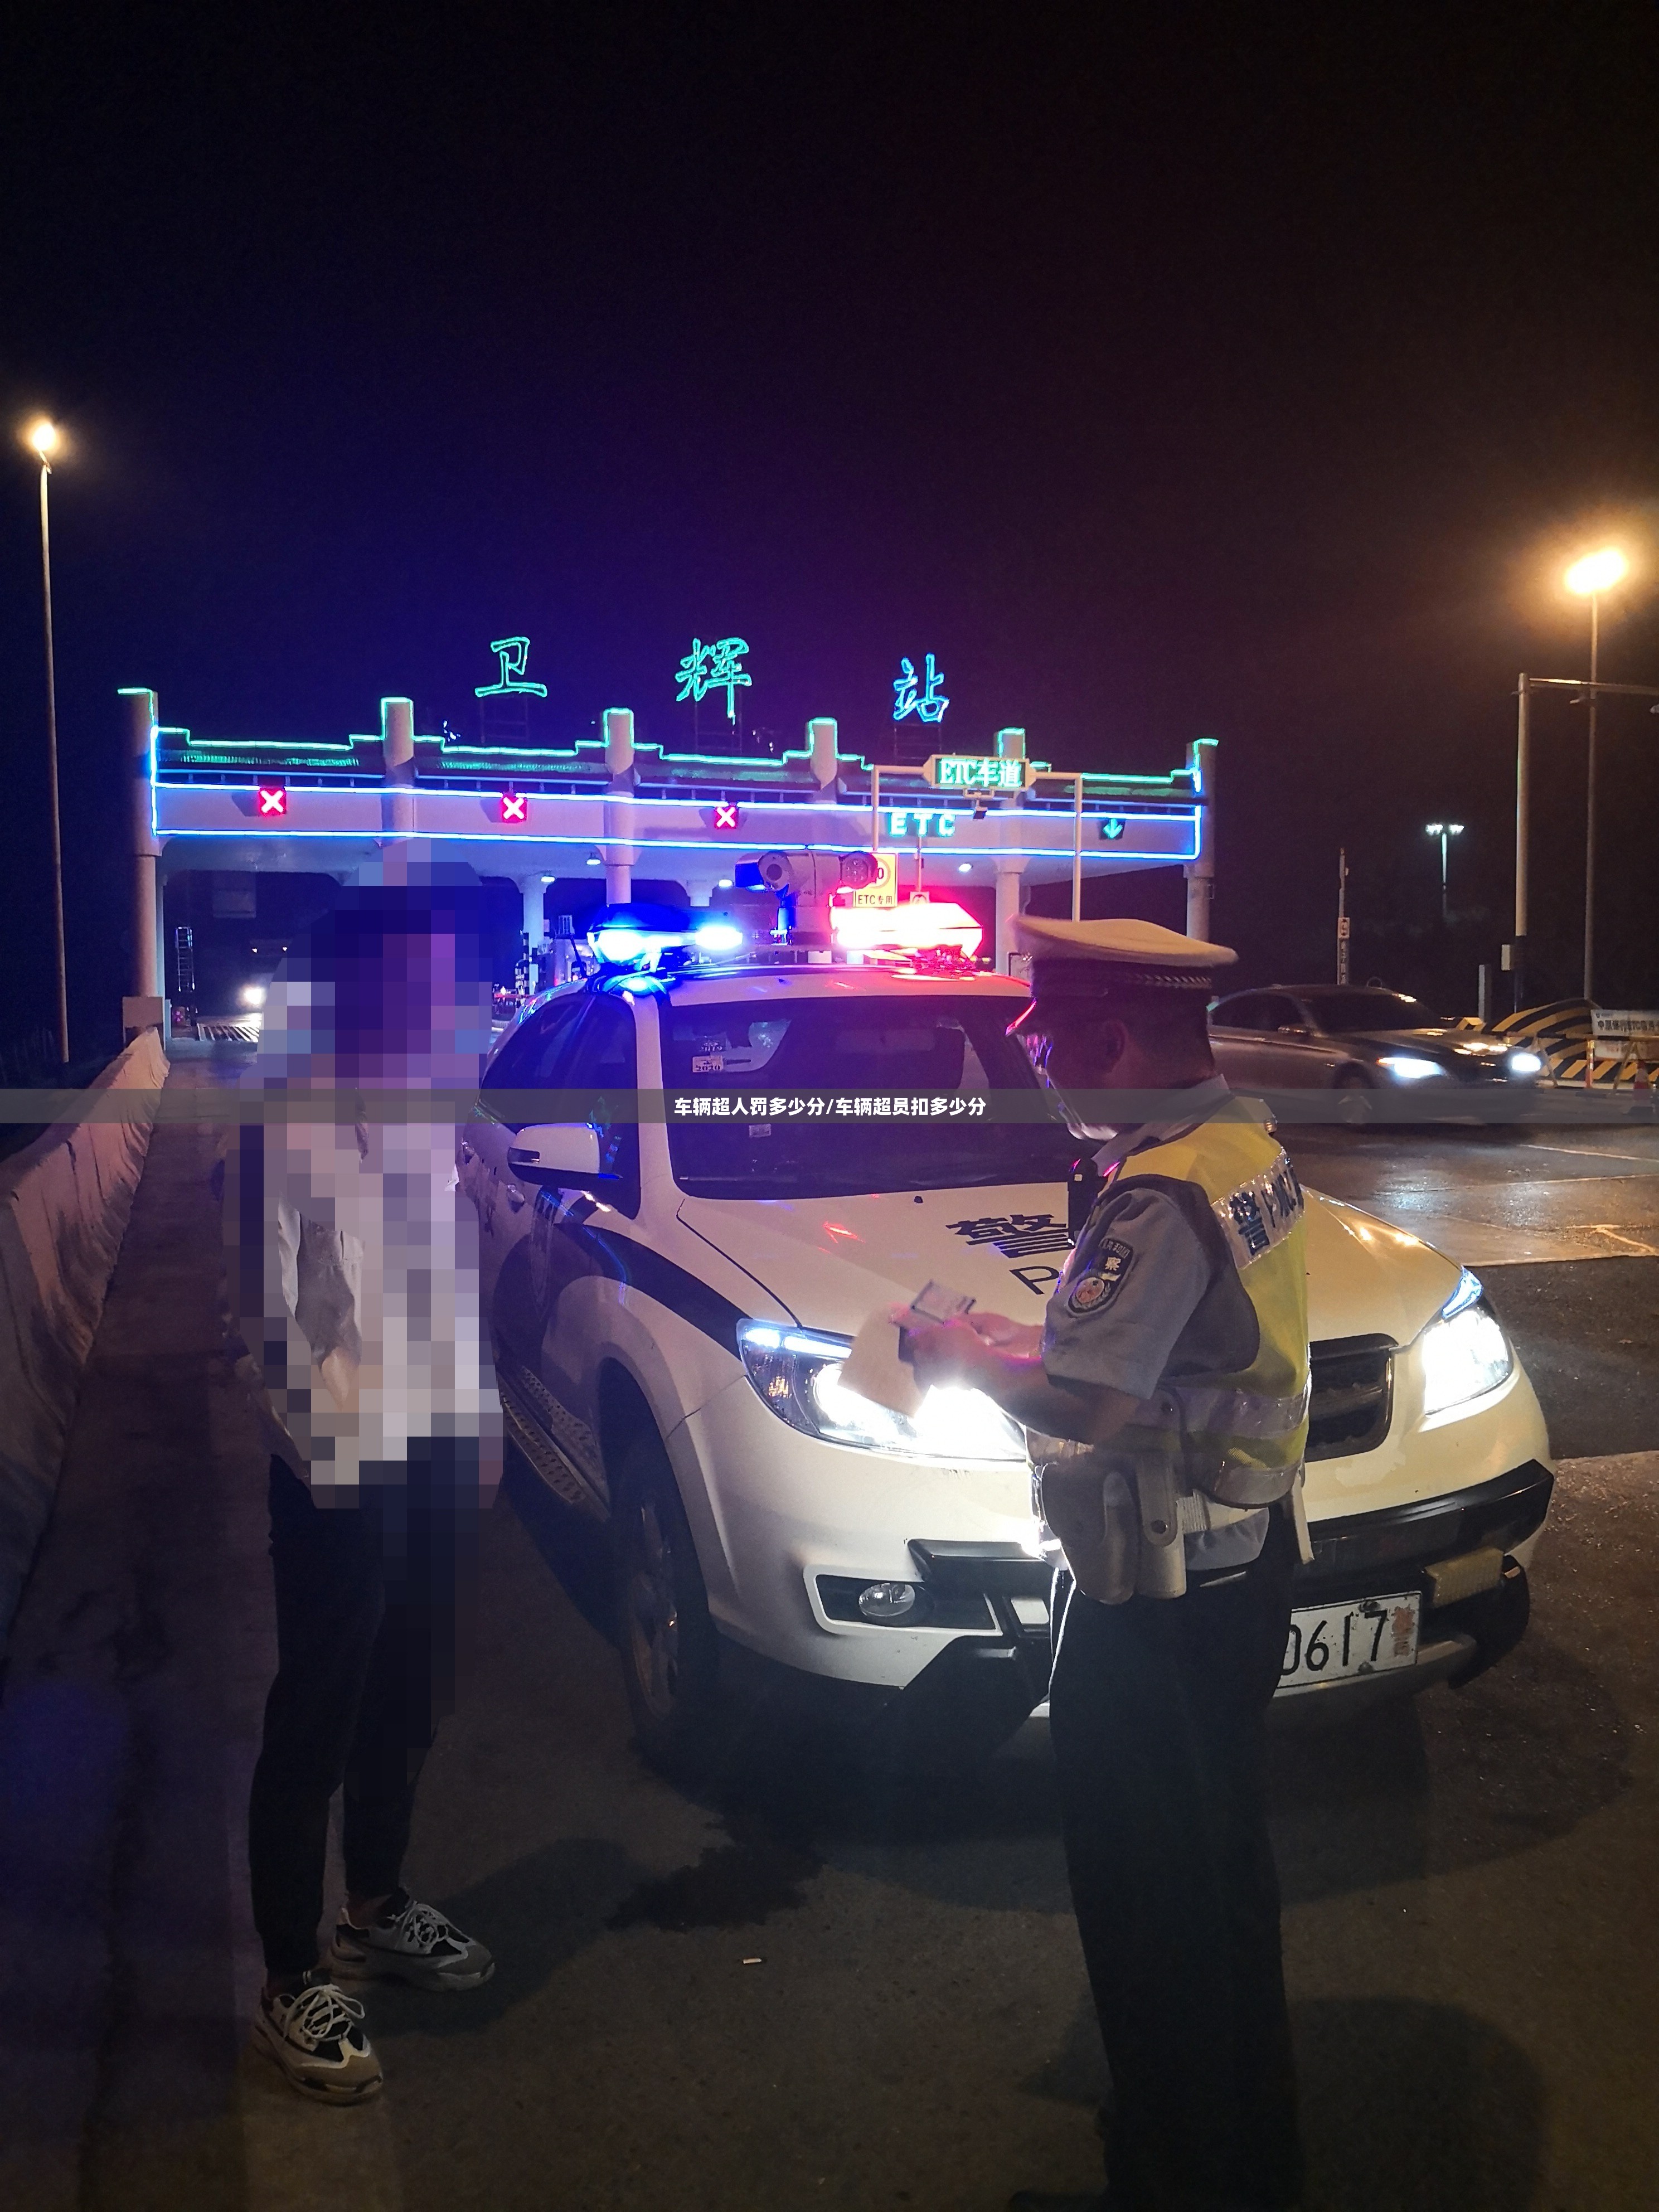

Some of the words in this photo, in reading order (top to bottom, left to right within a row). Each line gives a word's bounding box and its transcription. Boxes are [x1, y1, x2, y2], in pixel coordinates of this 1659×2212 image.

[475, 637, 949, 721] 卫辉站
[939, 757, 1022, 787] ETC车道
[889, 812, 956, 837] ETC
[945, 1214, 1076, 1259] 警
